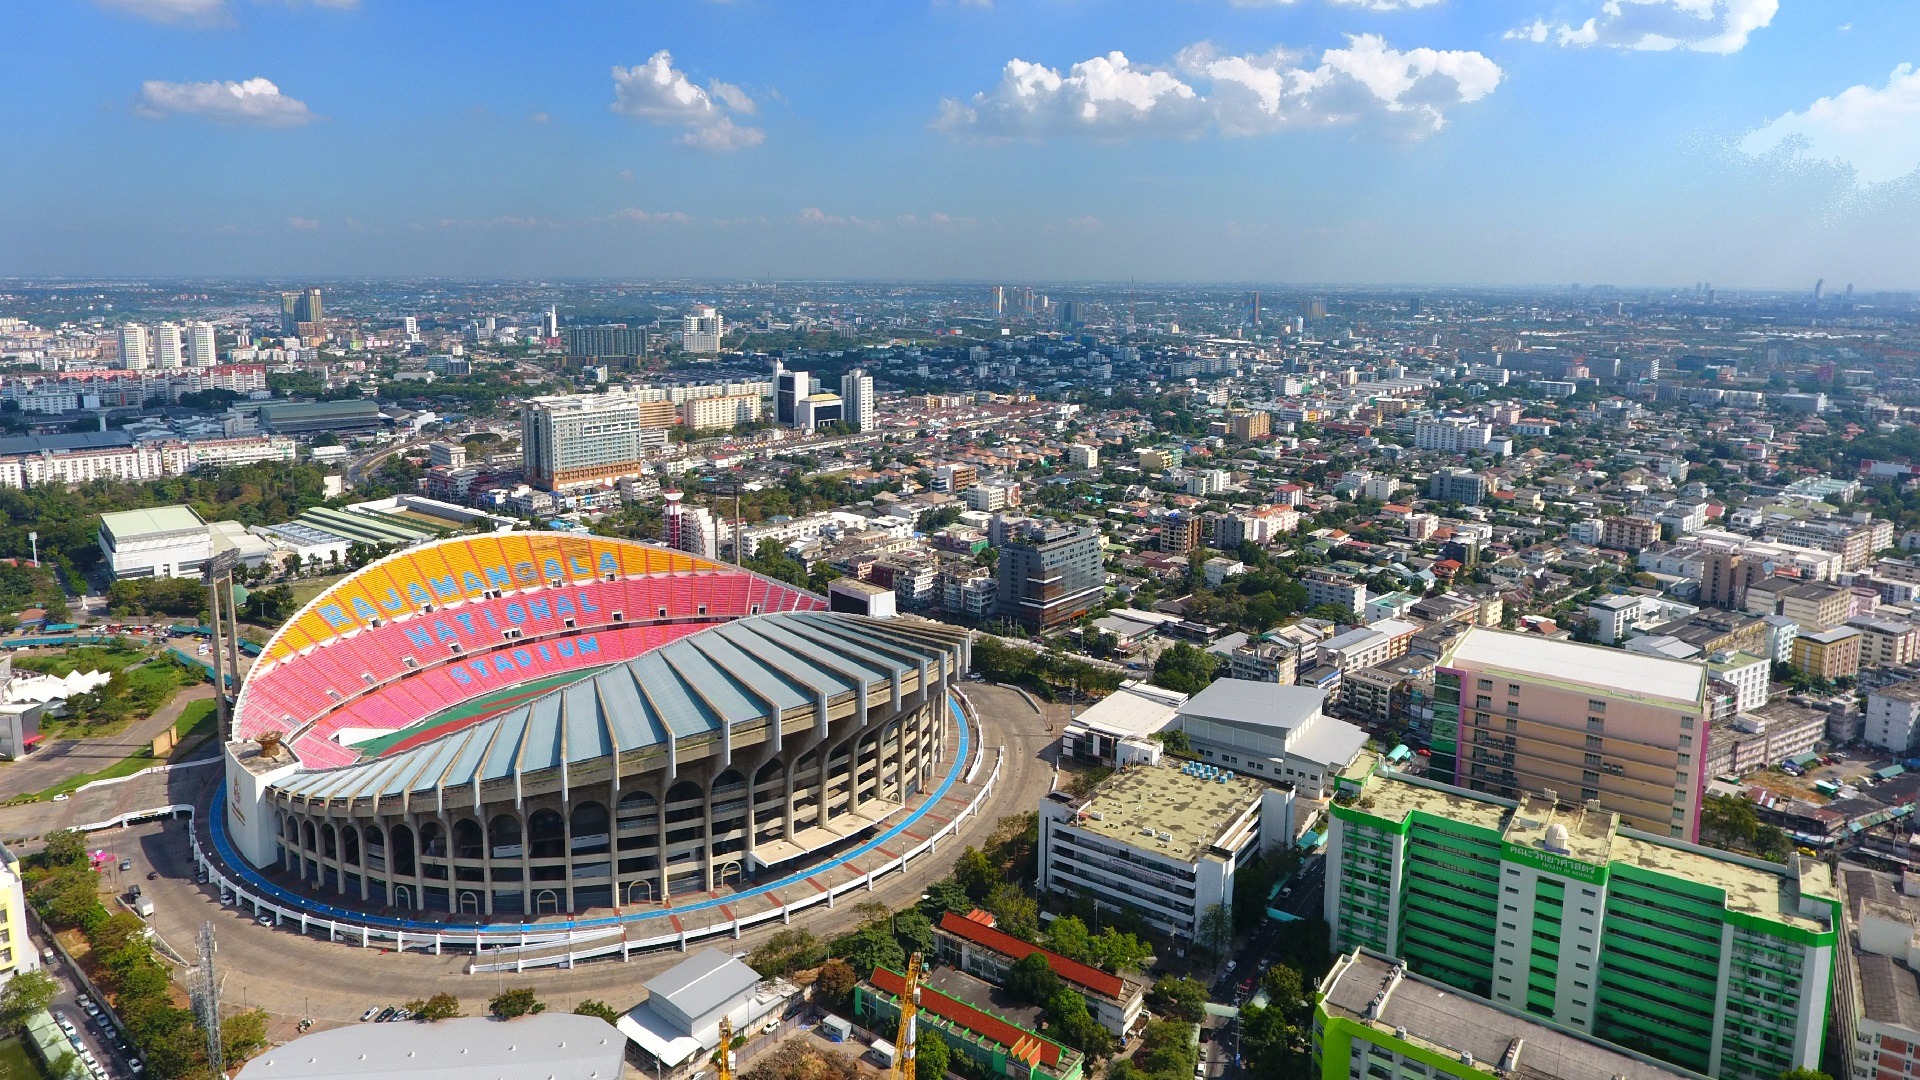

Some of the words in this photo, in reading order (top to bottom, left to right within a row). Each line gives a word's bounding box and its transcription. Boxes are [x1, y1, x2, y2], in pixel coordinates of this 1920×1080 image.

[317, 552, 618, 627] RAJAMANGALA
[404, 592, 598, 649] NATIONAL
[452, 636, 598, 684] STADIUM
